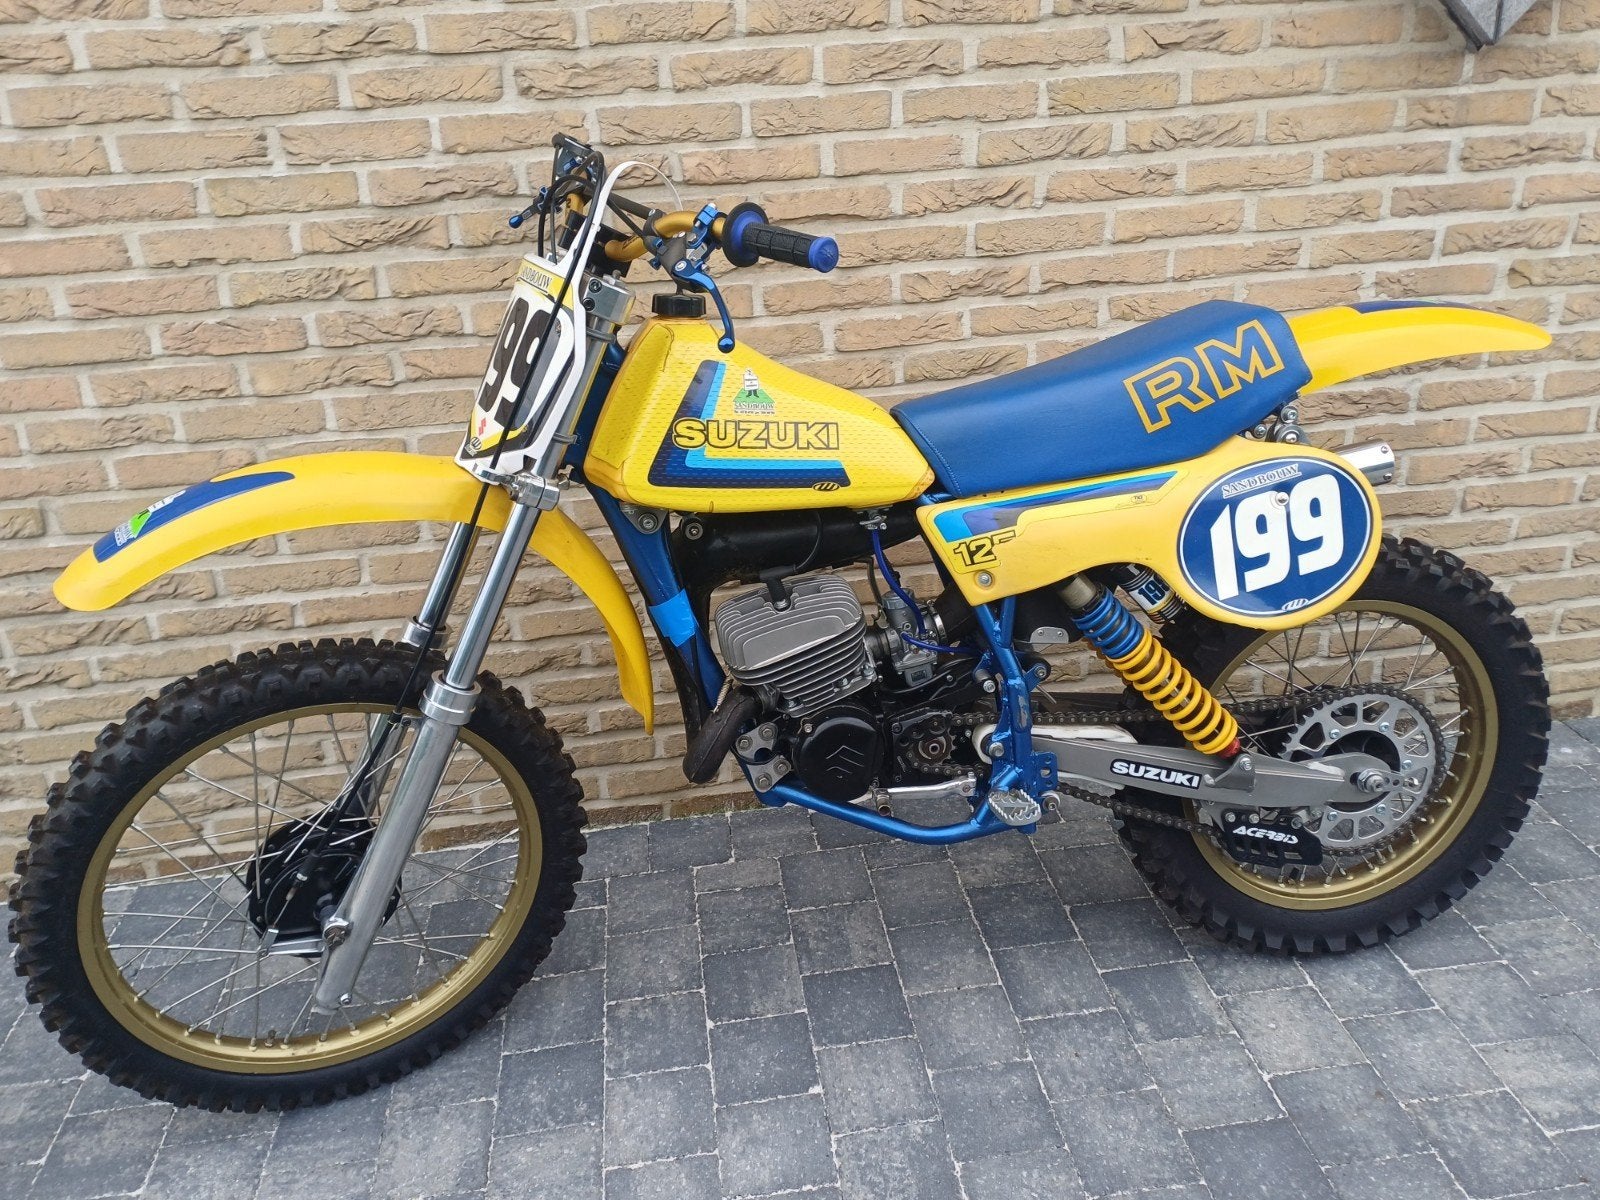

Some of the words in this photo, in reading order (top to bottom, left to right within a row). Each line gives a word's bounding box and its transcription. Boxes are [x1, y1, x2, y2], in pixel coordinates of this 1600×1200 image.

[1123, 319, 1285, 434] RM
[672, 417, 840, 450] SUZUKI
[1222, 464, 1300, 494] SANDBOUW
[1210, 474, 1344, 600] 199
[1112, 761, 1199, 788] SUZUKI
[1232, 825, 1299, 845] ACERBIS
